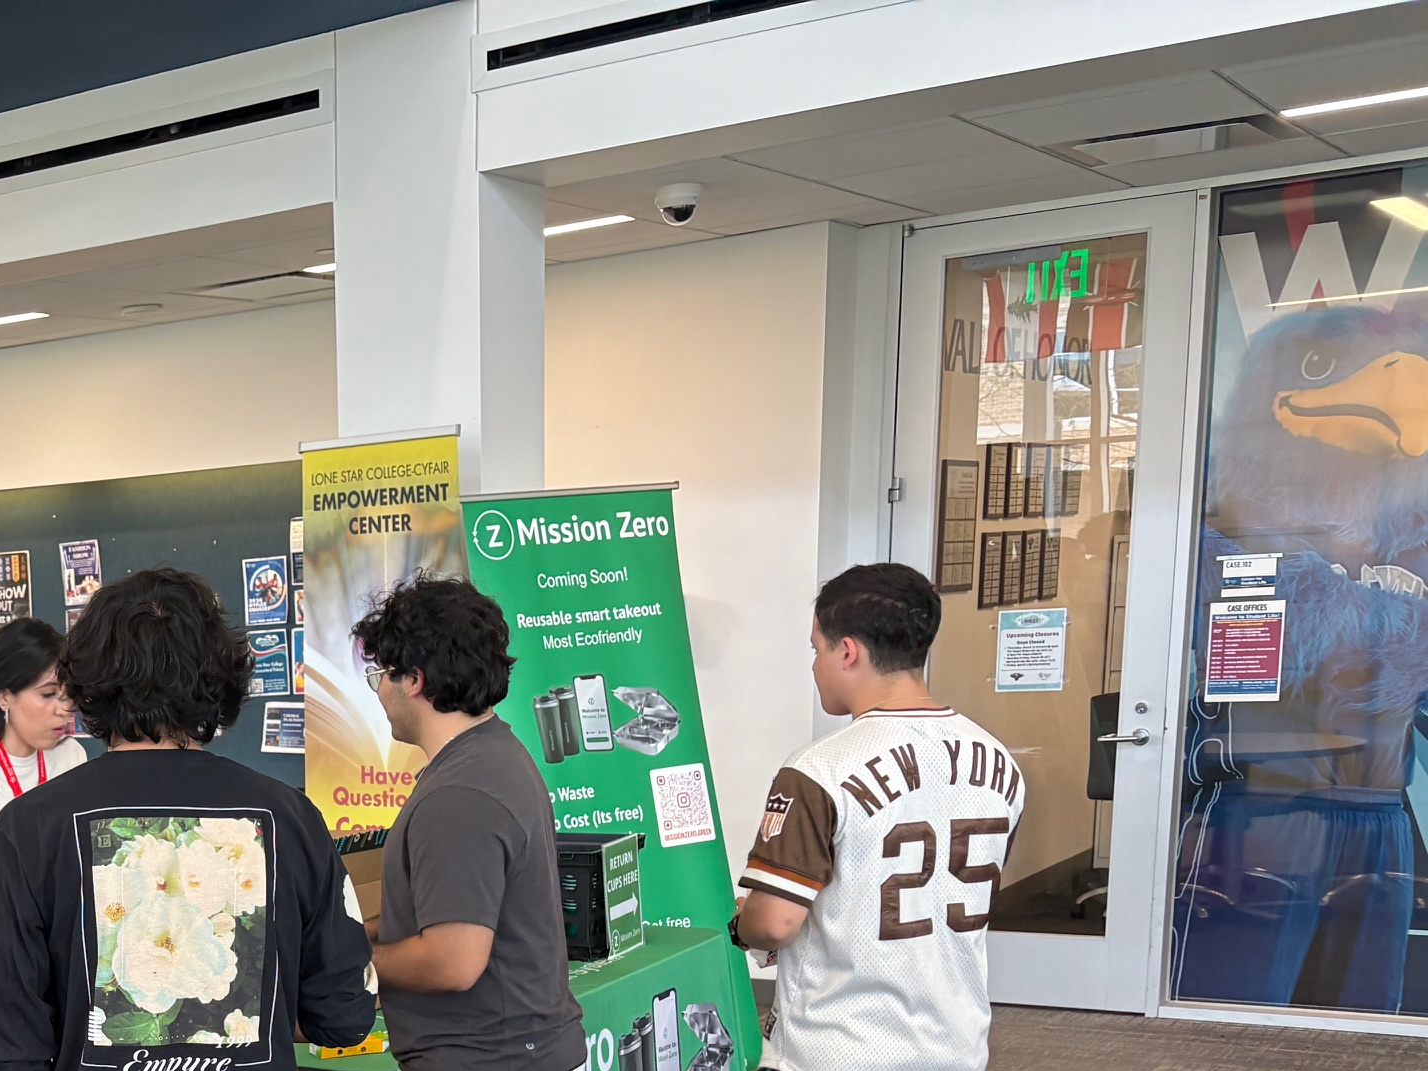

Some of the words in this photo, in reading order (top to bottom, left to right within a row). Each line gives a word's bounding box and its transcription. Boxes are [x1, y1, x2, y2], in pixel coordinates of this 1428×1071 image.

[311, 471, 338, 486] LONE
[341, 469, 363, 483] STAR
[366, 461, 450, 480] COLLEGE-CYFAIR
[313, 483, 449, 511] EMPOWERMENT
[349, 514, 412, 534] CENTER
[516, 515, 611, 546] Mission
[616, 511, 670, 538] Zero
[537, 571, 587, 588] Coming
[590, 567, 628, 585] Soon!
[517, 610, 572, 628] Reusable
[575, 607, 610, 624] smart
[613, 602, 662, 619] takeout
[1227, 604, 1243, 612] CASE
[1243, 603, 1268, 612] OFFICES
[543, 634, 573, 650] Most
[575, 627, 642, 647] Ecofriendly
[361, 765, 413, 785] Have
[840, 743, 921, 817] NEW
[557, 786, 595, 802] Waste
[564, 814, 590, 829] Cost
[592, 810, 613, 829] (Its
[615, 805, 644, 822] free)
[609, 851, 633, 870] RETURN
[607, 875, 623, 893] CUPS
[623, 869, 638, 887] HERE
[879, 817, 1010, 941] 25
[215, 1035, 254, 1048] 1999
